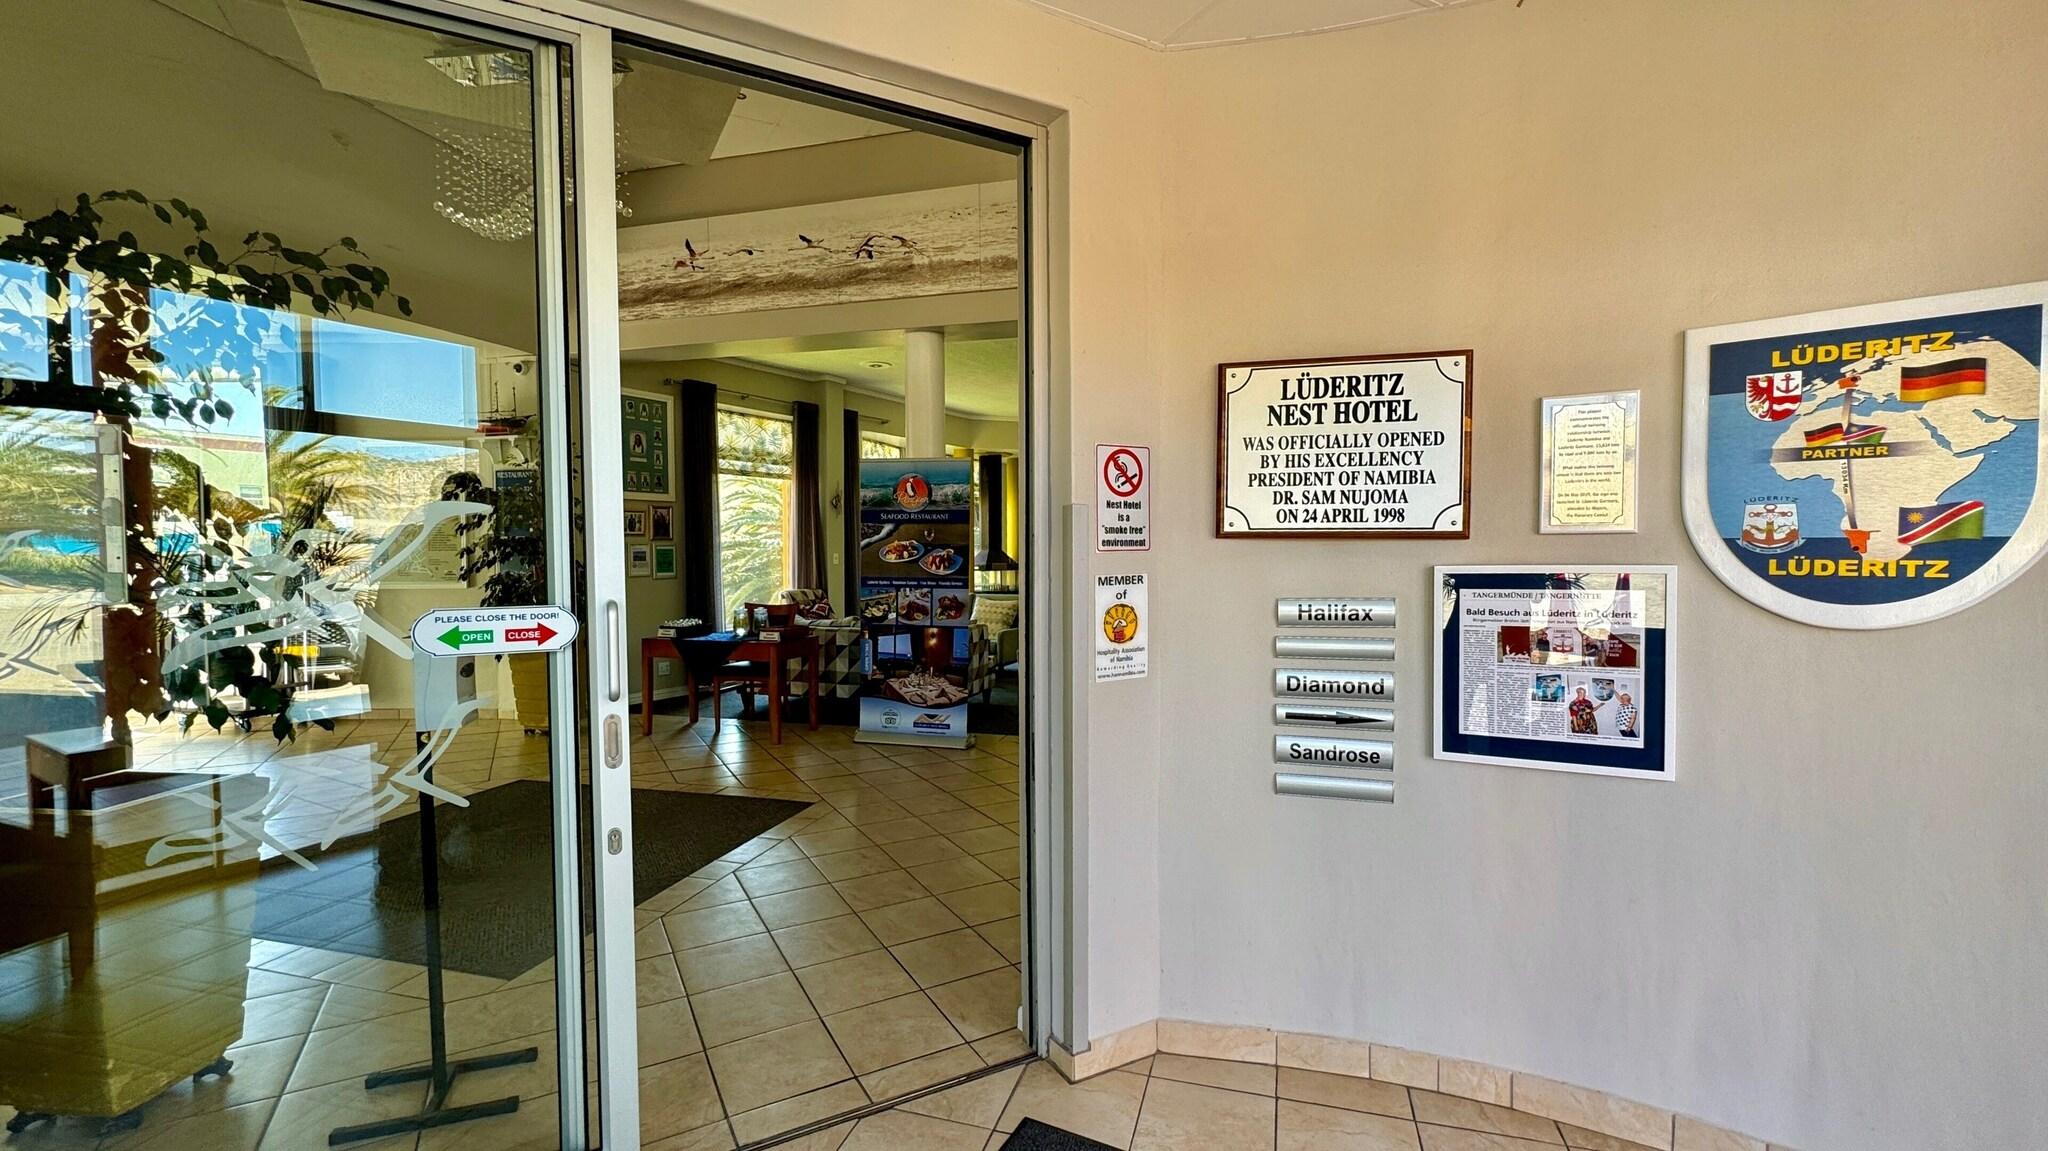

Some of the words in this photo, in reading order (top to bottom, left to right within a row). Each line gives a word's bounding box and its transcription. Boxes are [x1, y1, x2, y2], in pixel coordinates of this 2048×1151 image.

[1771, 331, 1956, 369] LÜDERITZ
[1280, 372, 1404, 400] LÜDERITZ
[1267, 403, 1327, 427] NEST
[1333, 400, 1418, 424] HOTEL
[1242, 436, 1274, 451] WAS
[1278, 432, 1374, 450] OFFICIALLY
[1377, 430, 1445, 448] OPENED
[1260, 454, 1281, 469] BY
[1284, 453, 1311, 468] HIS
[1314, 450, 1424, 468] EXCELLENCY
[1802, 445, 1889, 460] PARTNER
[1248, 471, 1335, 488] PRESIDENT
[1338, 470, 1360, 486] OF
[1363, 469, 1437, 485] NAMIBIA
[1272, 490, 1298, 505] DR.
[1301, 490, 1336, 504] SAM
[1340, 489, 1409, 505] NUJOMA
[1743, 495, 1800, 504] LÜDERITZ
[1106, 500, 1122, 509] Nest
[1123, 500, 1142, 510] Hotel
[1117, 512, 1124, 522] is
[1126, 514, 1130, 522] a
[1276, 508, 1299, 524] ON
[1302, 508, 1318, 523] 24
[1320, 508, 1369, 523] APRIL
[1374, 508, 1405, 522] 1998
[1102, 538, 1146, 547] environment
[1768, 556, 1951, 578] LÜDERITZ
[1098, 574, 1144, 586] MEMBER
[1116, 589, 1127, 600] of
[1472, 592, 1534, 600] TANGERMÜNDE
[434, 614, 472, 624] PLEASE
[475, 614, 507, 622] CLOSE
[509, 613, 528, 621] THE
[530, 612, 560, 620] DOOR!
[1297, 604, 1374, 622] Halifax
[1466, 608, 1486, 616] Bald
[1488, 608, 1520, 616] Besuch
[1584, 610, 1594, 618] in
[462, 632, 491, 642] OPEN
[508, 630, 541, 640] CLOSE
[1286, 676, 1385, 695] Diamond
[1289, 742, 1380, 764] Sandrose
